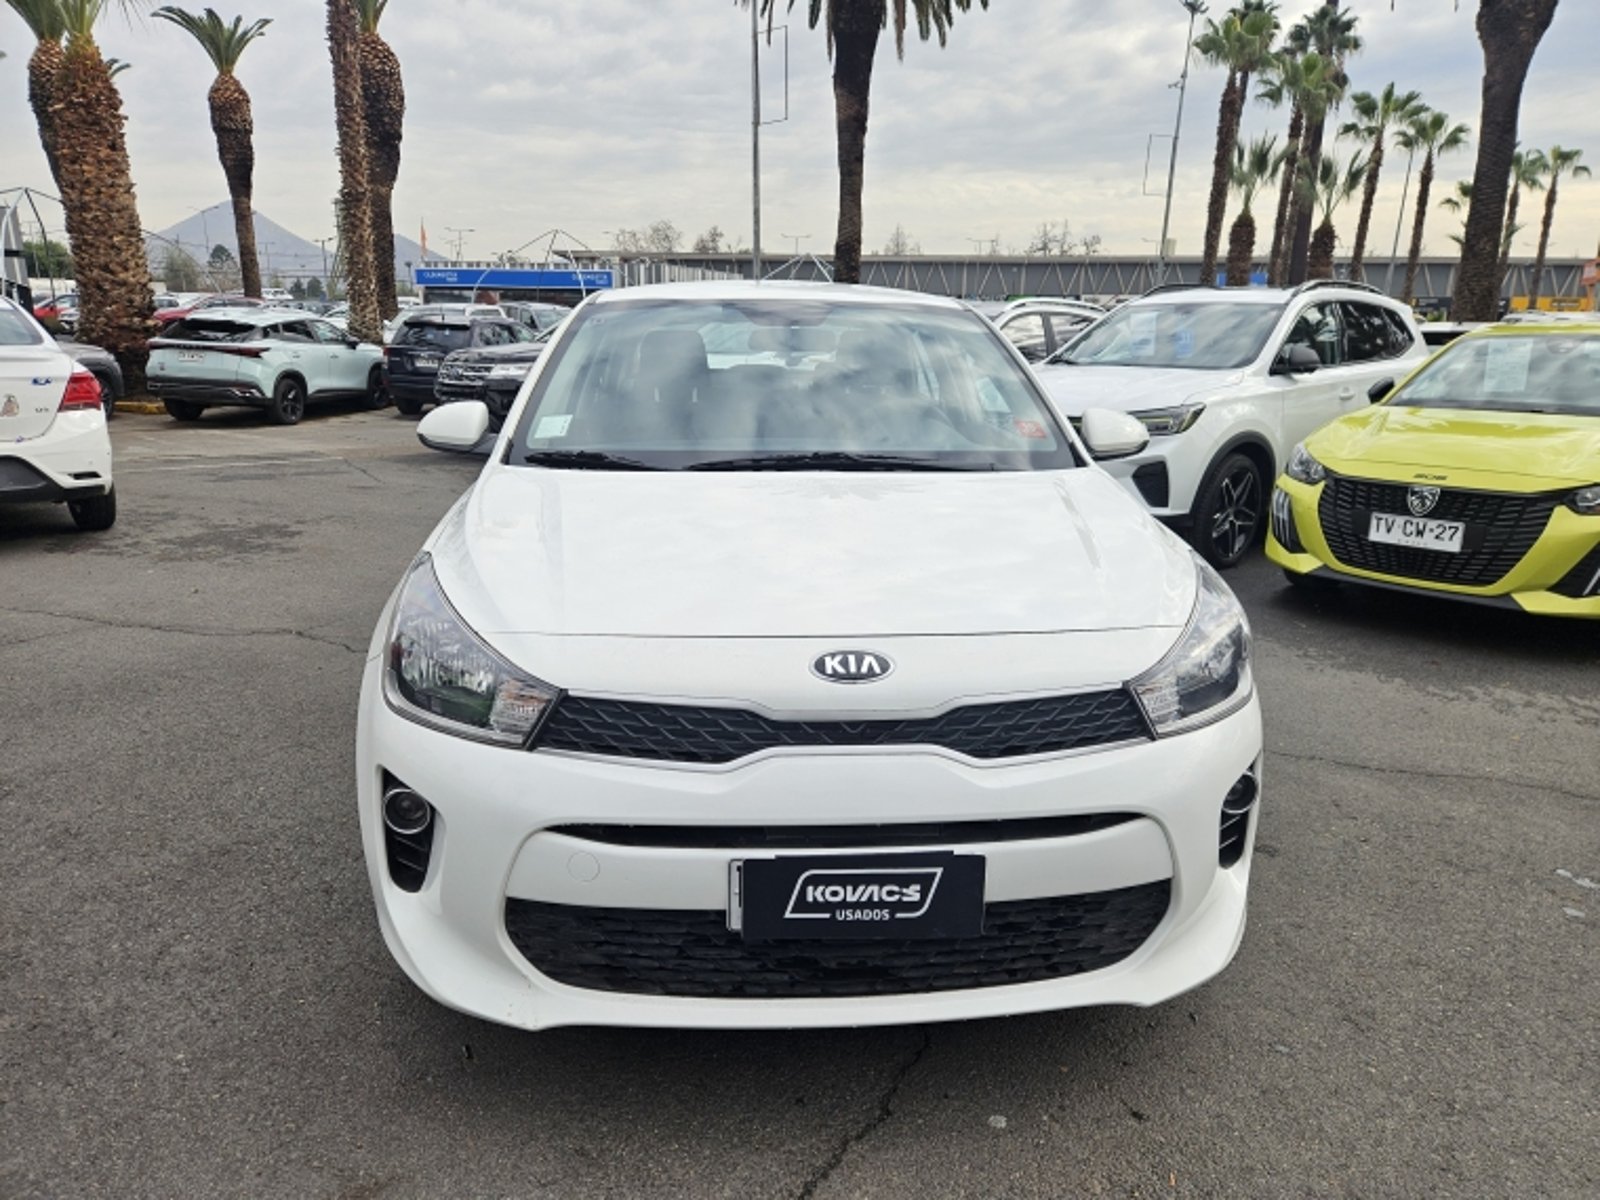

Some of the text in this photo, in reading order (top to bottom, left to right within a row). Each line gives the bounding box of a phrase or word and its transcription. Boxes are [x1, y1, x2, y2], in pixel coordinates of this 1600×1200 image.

[824, 653, 882, 675] KIA
[806, 883, 922, 902] KOVACS
[835, 908, 890, 921] USADOS
